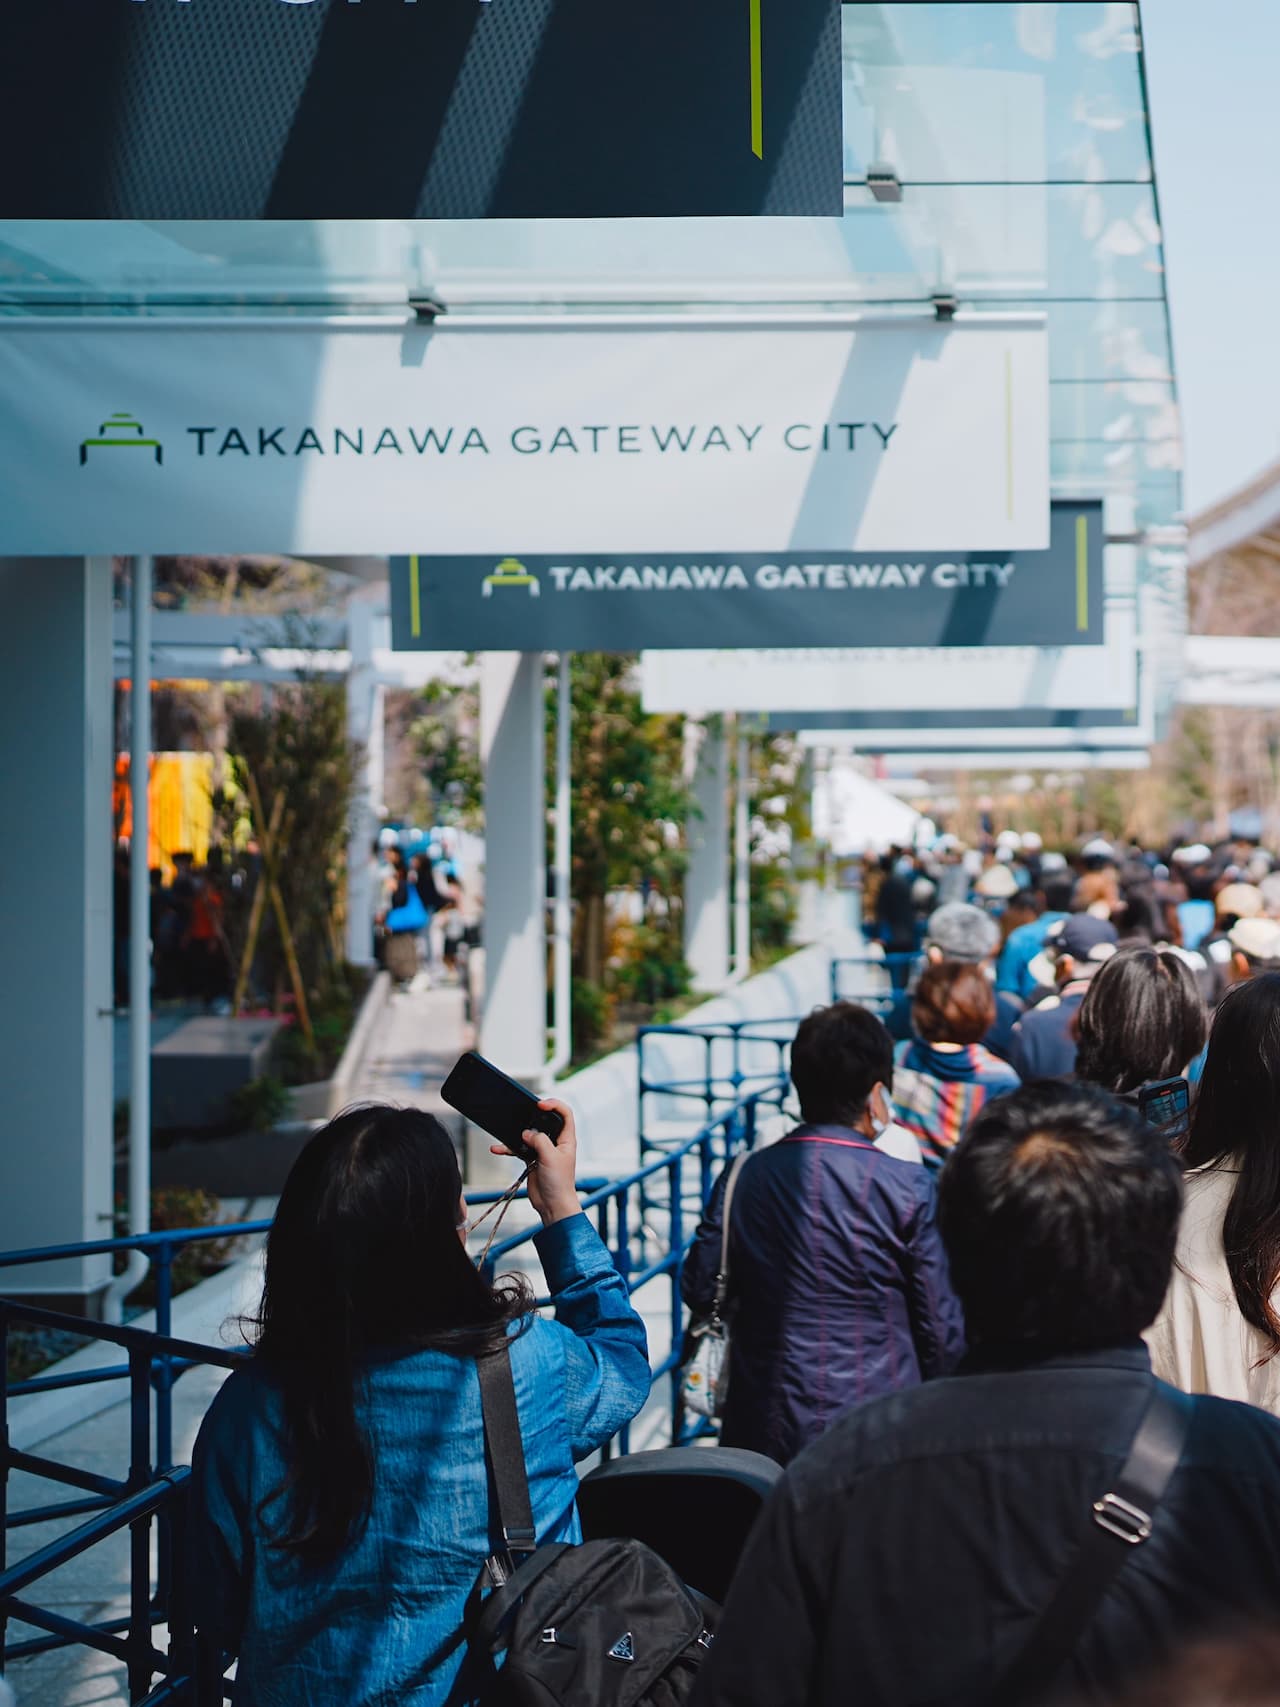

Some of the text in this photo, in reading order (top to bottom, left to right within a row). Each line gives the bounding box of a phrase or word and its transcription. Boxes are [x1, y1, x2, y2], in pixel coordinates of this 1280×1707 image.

[186, 423, 899, 456] TAKANAWA GATEWAY CITY
[550, 562, 1015, 591] TAKANAWA GATEWAY CITY
